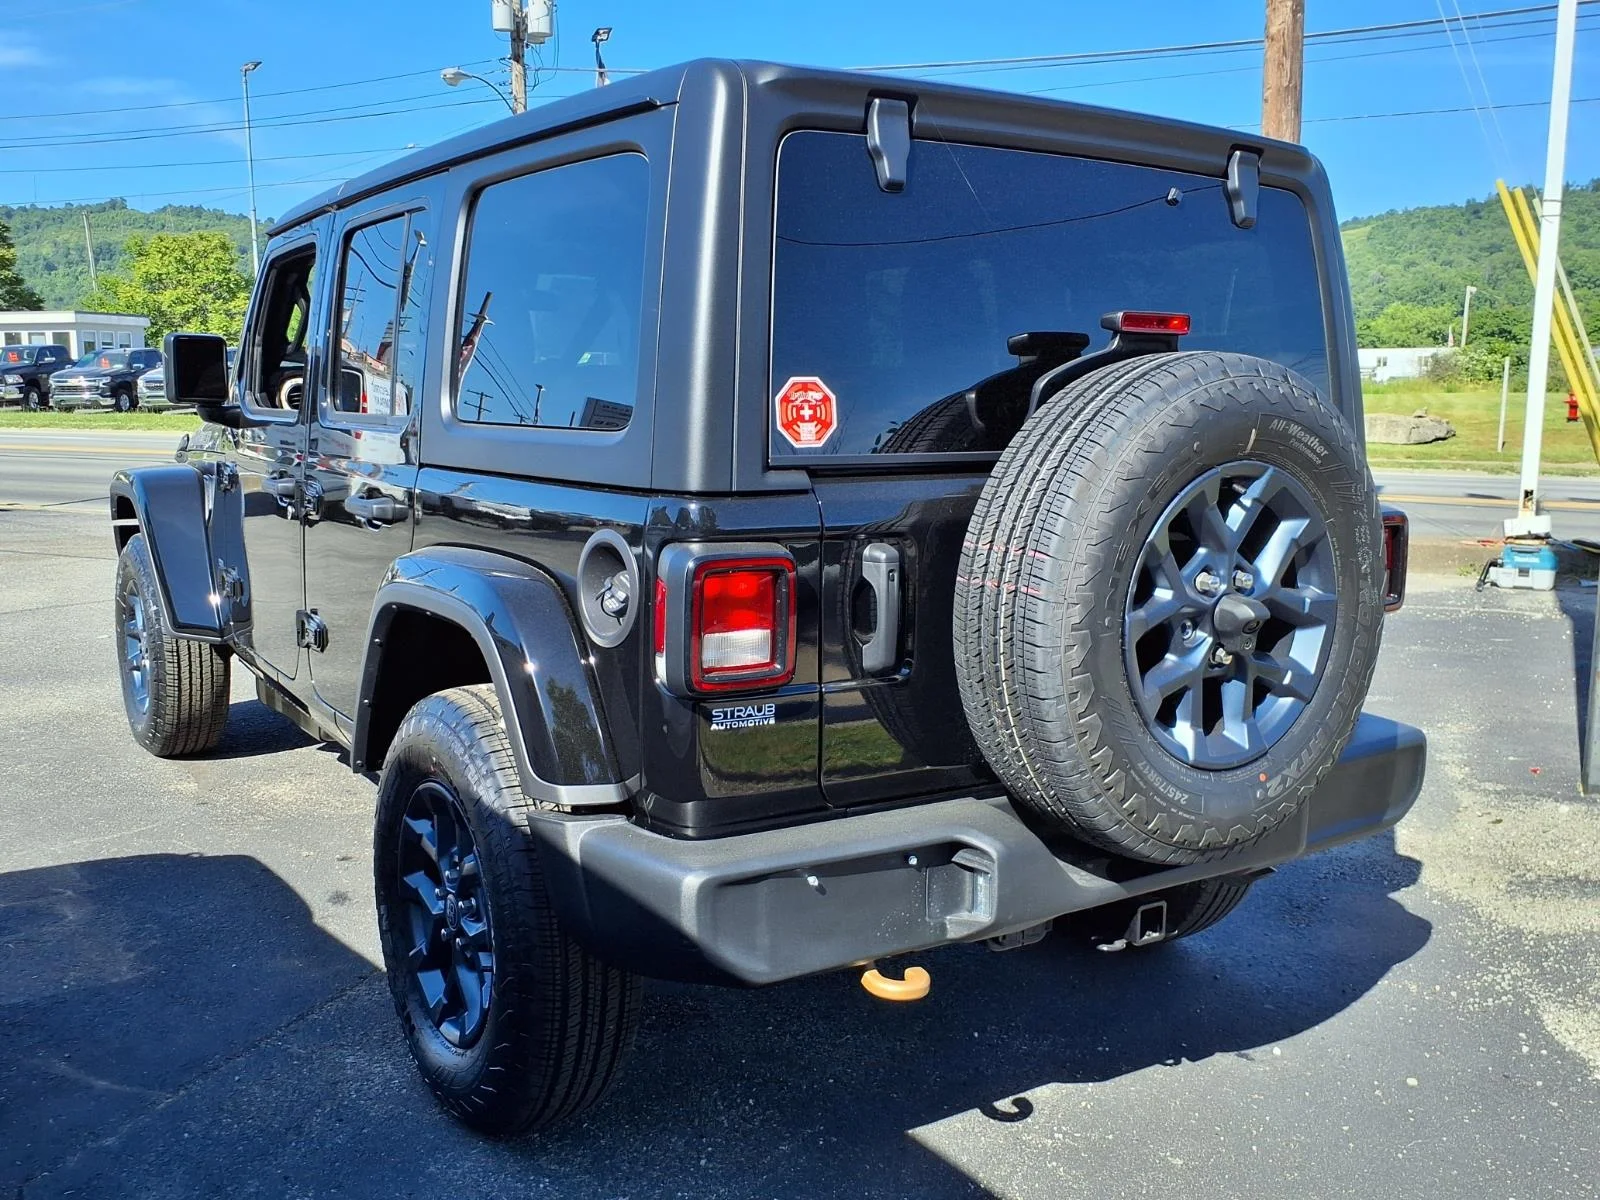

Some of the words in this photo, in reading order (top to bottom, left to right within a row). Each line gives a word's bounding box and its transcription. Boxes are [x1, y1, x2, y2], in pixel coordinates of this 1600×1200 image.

[1269, 418, 1329, 457] All-Weather
[1288, 437, 1322, 465] Performance
[710, 716, 776, 731] AUTOMOTIVE
[711, 703, 776, 720] STRAUB
[1138, 760, 1189, 805] 245/75R17
